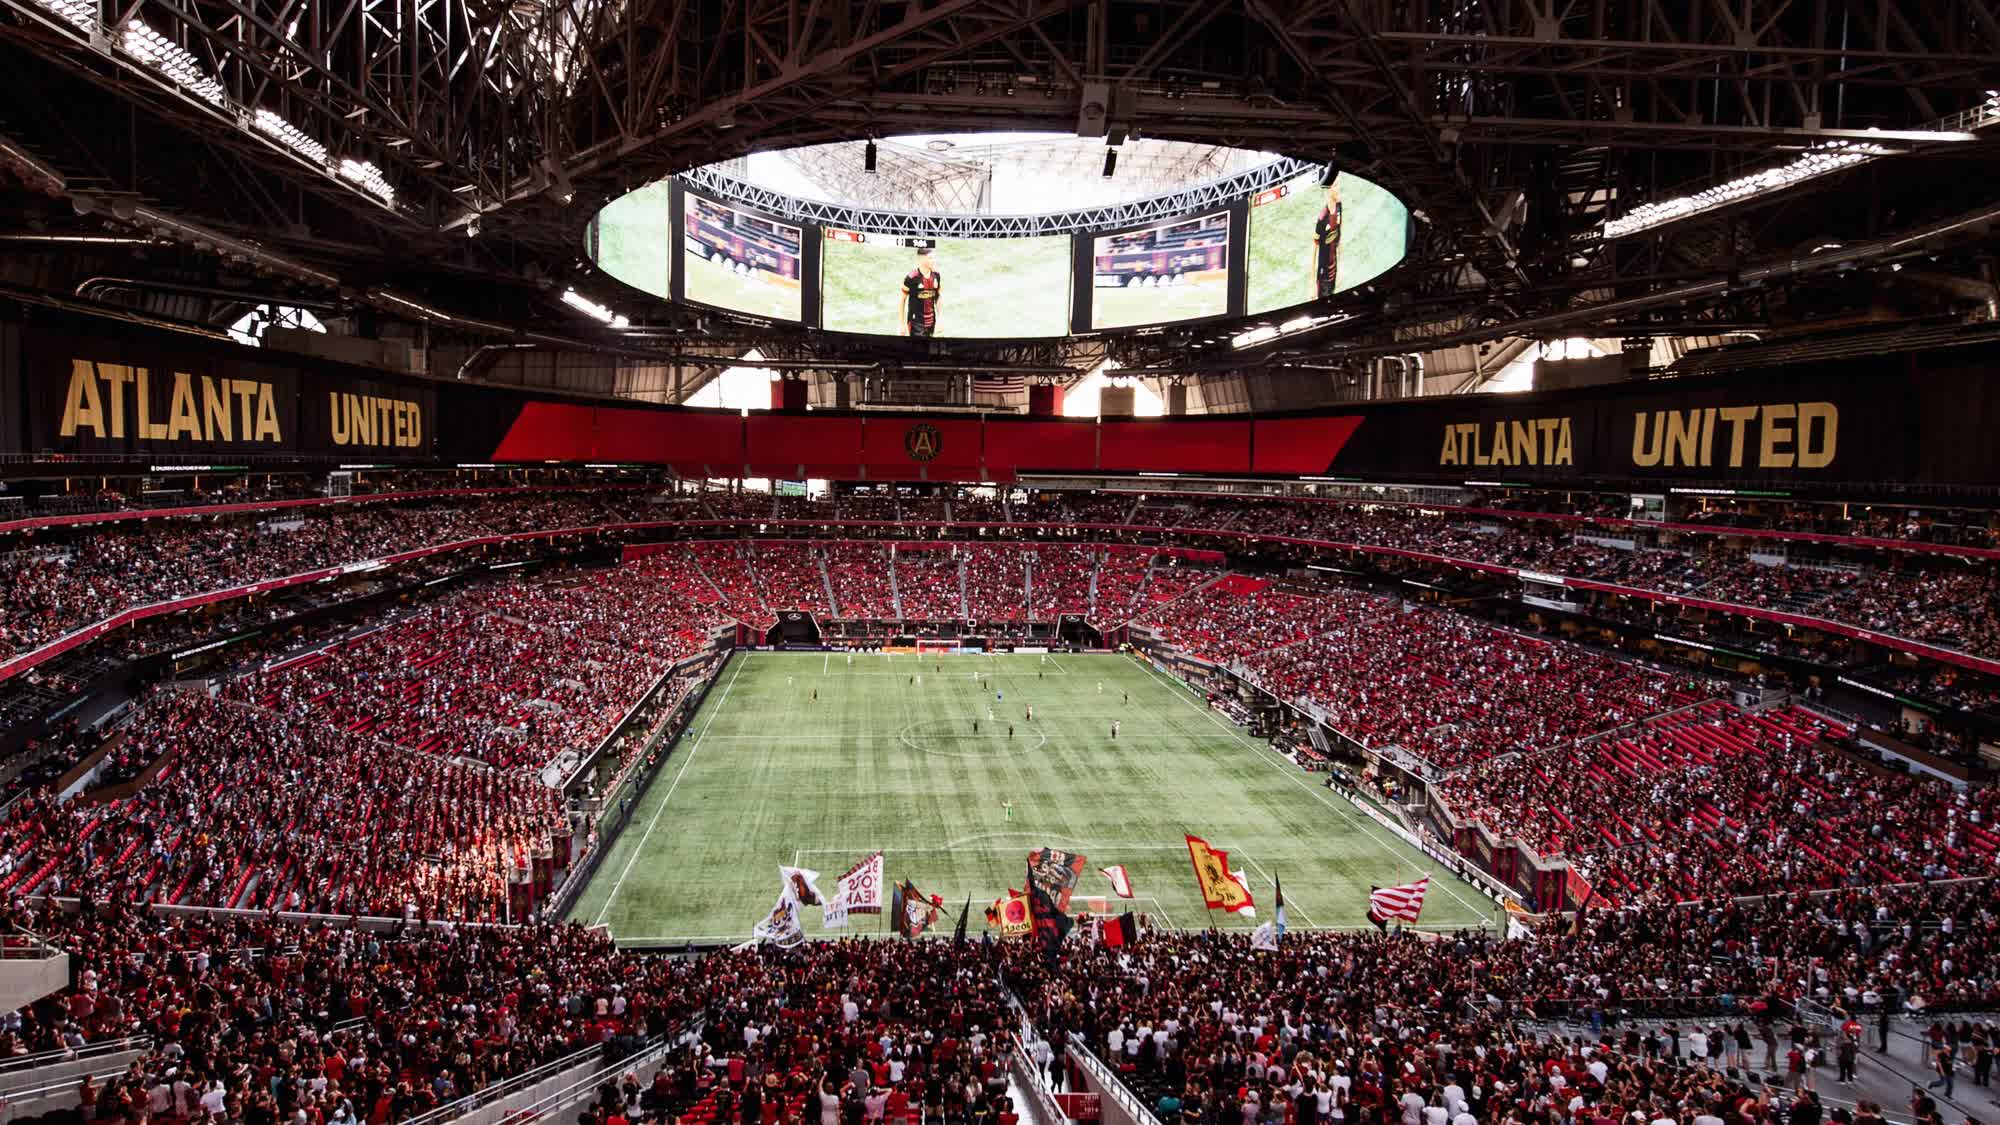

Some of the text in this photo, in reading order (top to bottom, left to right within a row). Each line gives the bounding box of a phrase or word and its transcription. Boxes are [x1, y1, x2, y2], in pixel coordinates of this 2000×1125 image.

[60, 359, 421, 447] ATLANTA UNITED
[1440, 402, 1838, 468] ATLANTA UNITED
